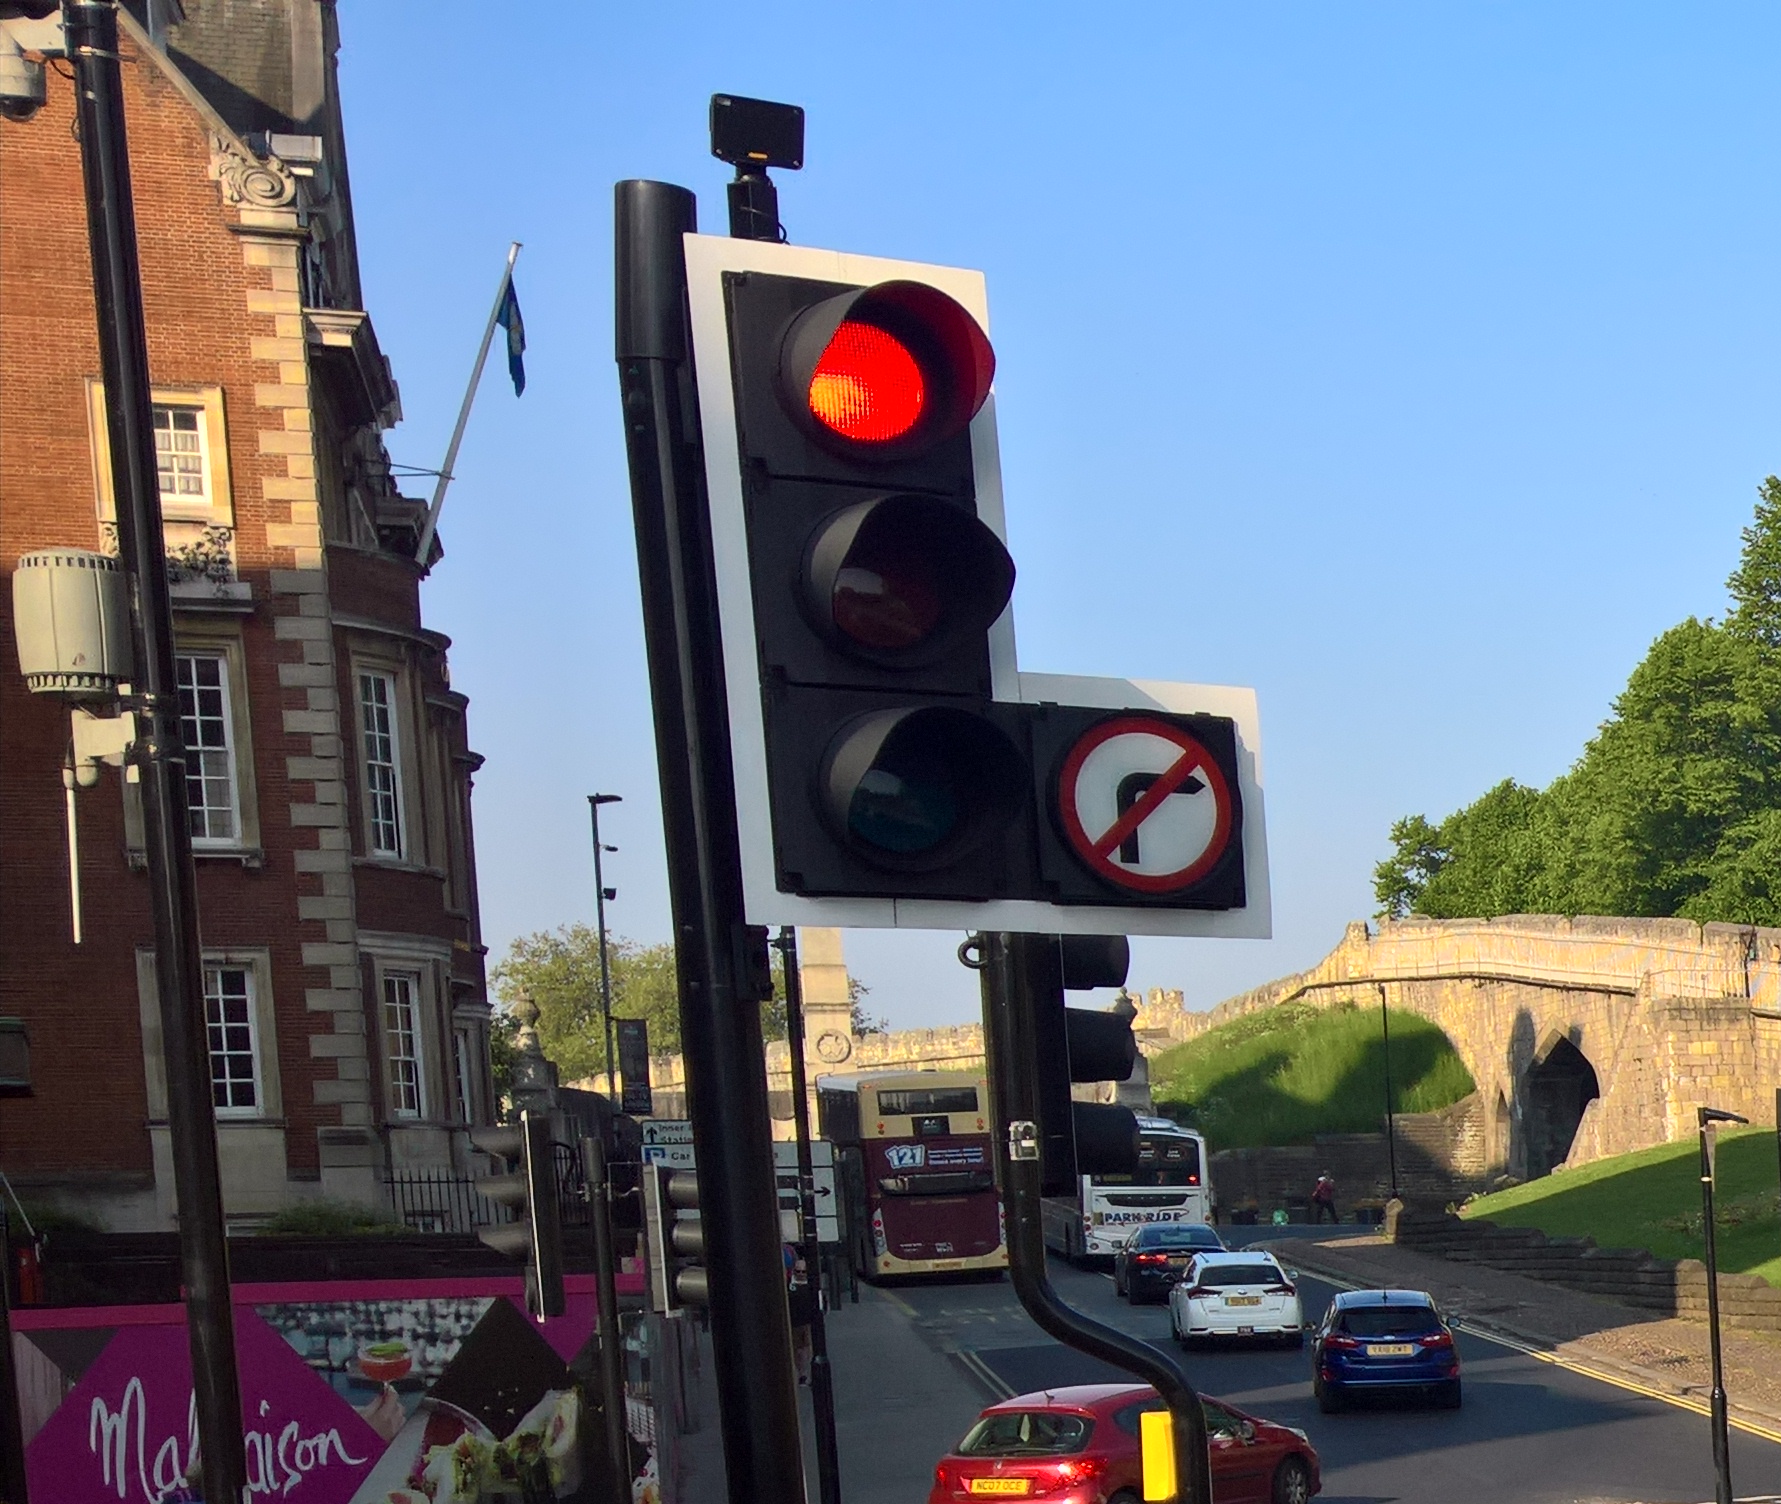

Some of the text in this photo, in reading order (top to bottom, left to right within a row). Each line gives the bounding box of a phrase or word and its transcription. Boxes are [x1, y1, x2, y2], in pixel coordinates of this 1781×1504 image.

[671, 1152, 690, 1161] Car
[886, 1145, 925, 1169] 121
[1105, 1212, 1182, 1222] PARK RIDE
[976, 1482, 1001, 1490] NC07
